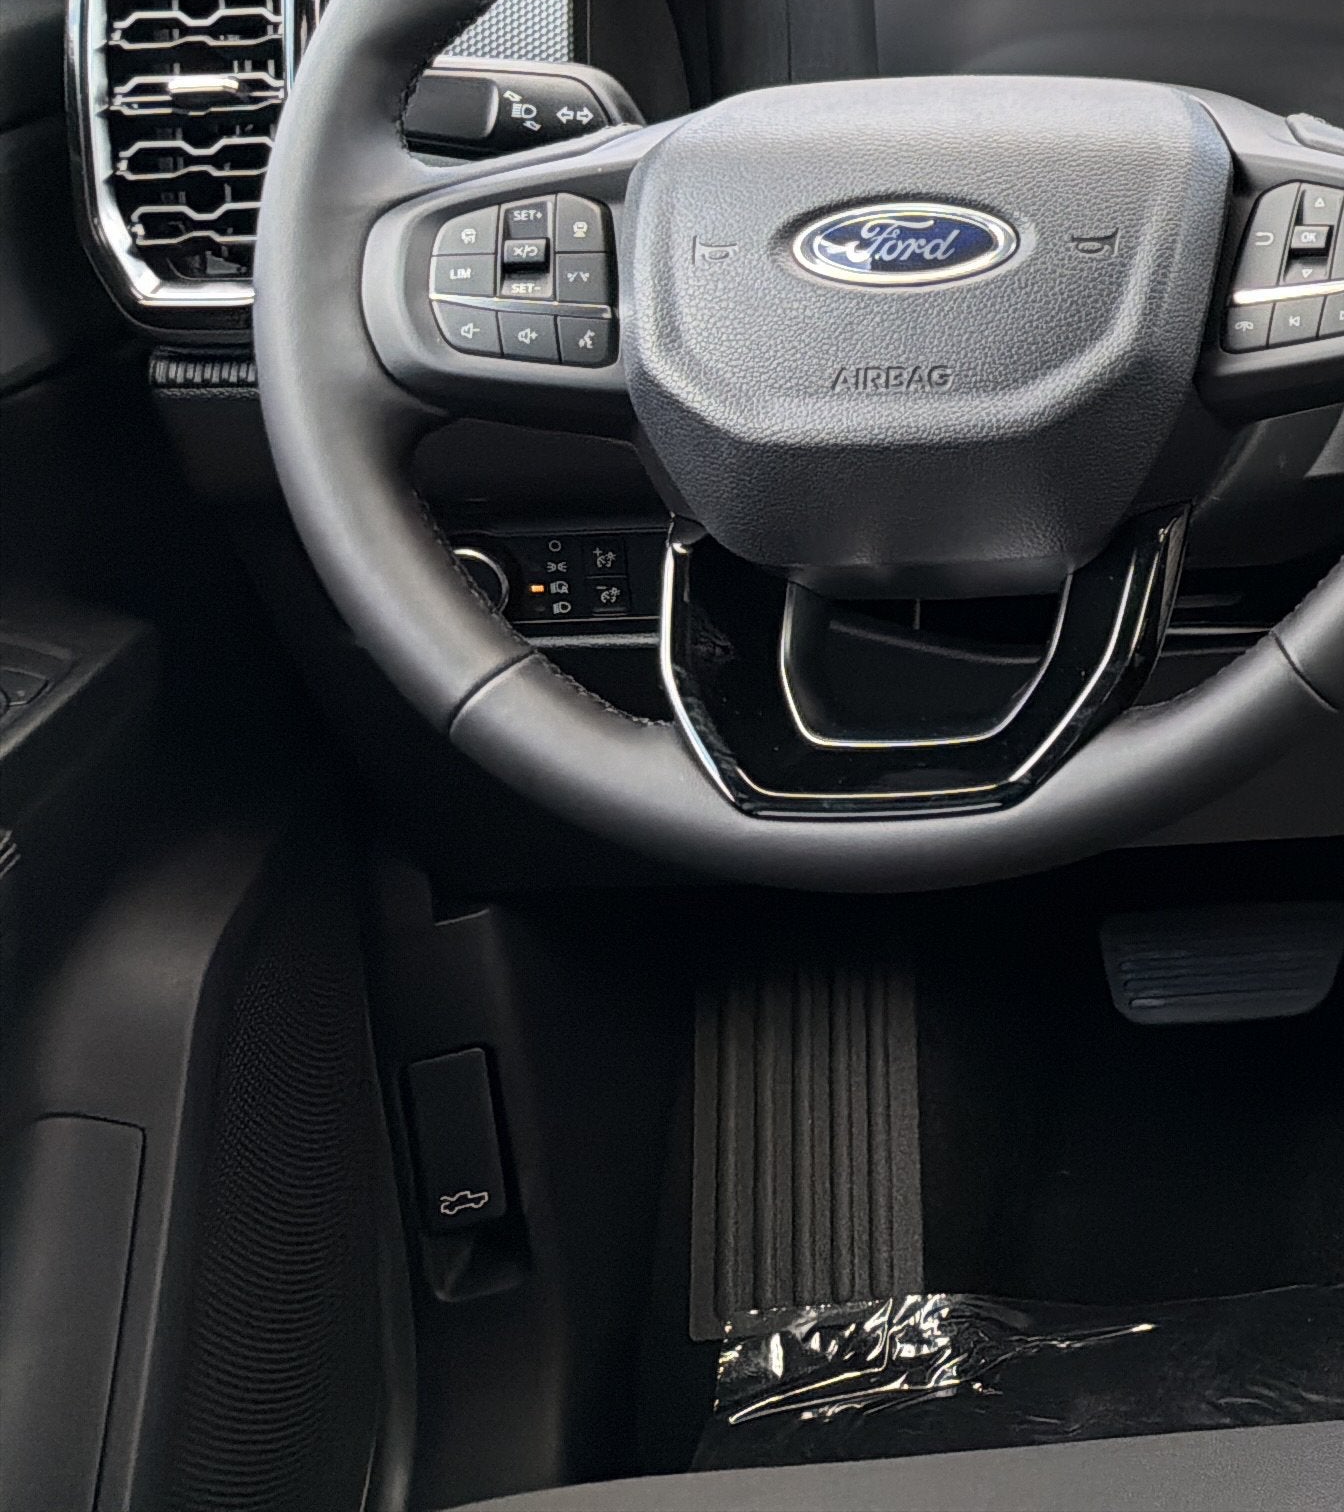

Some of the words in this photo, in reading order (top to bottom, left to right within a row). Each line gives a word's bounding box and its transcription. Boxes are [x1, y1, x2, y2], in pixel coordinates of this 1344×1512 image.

[848, 218, 962, 263] Ford
[1301, 232, 1318, 243] OK
[450, 268, 472, 280] LIM
[832, 364, 954, 390] AIRBAG
